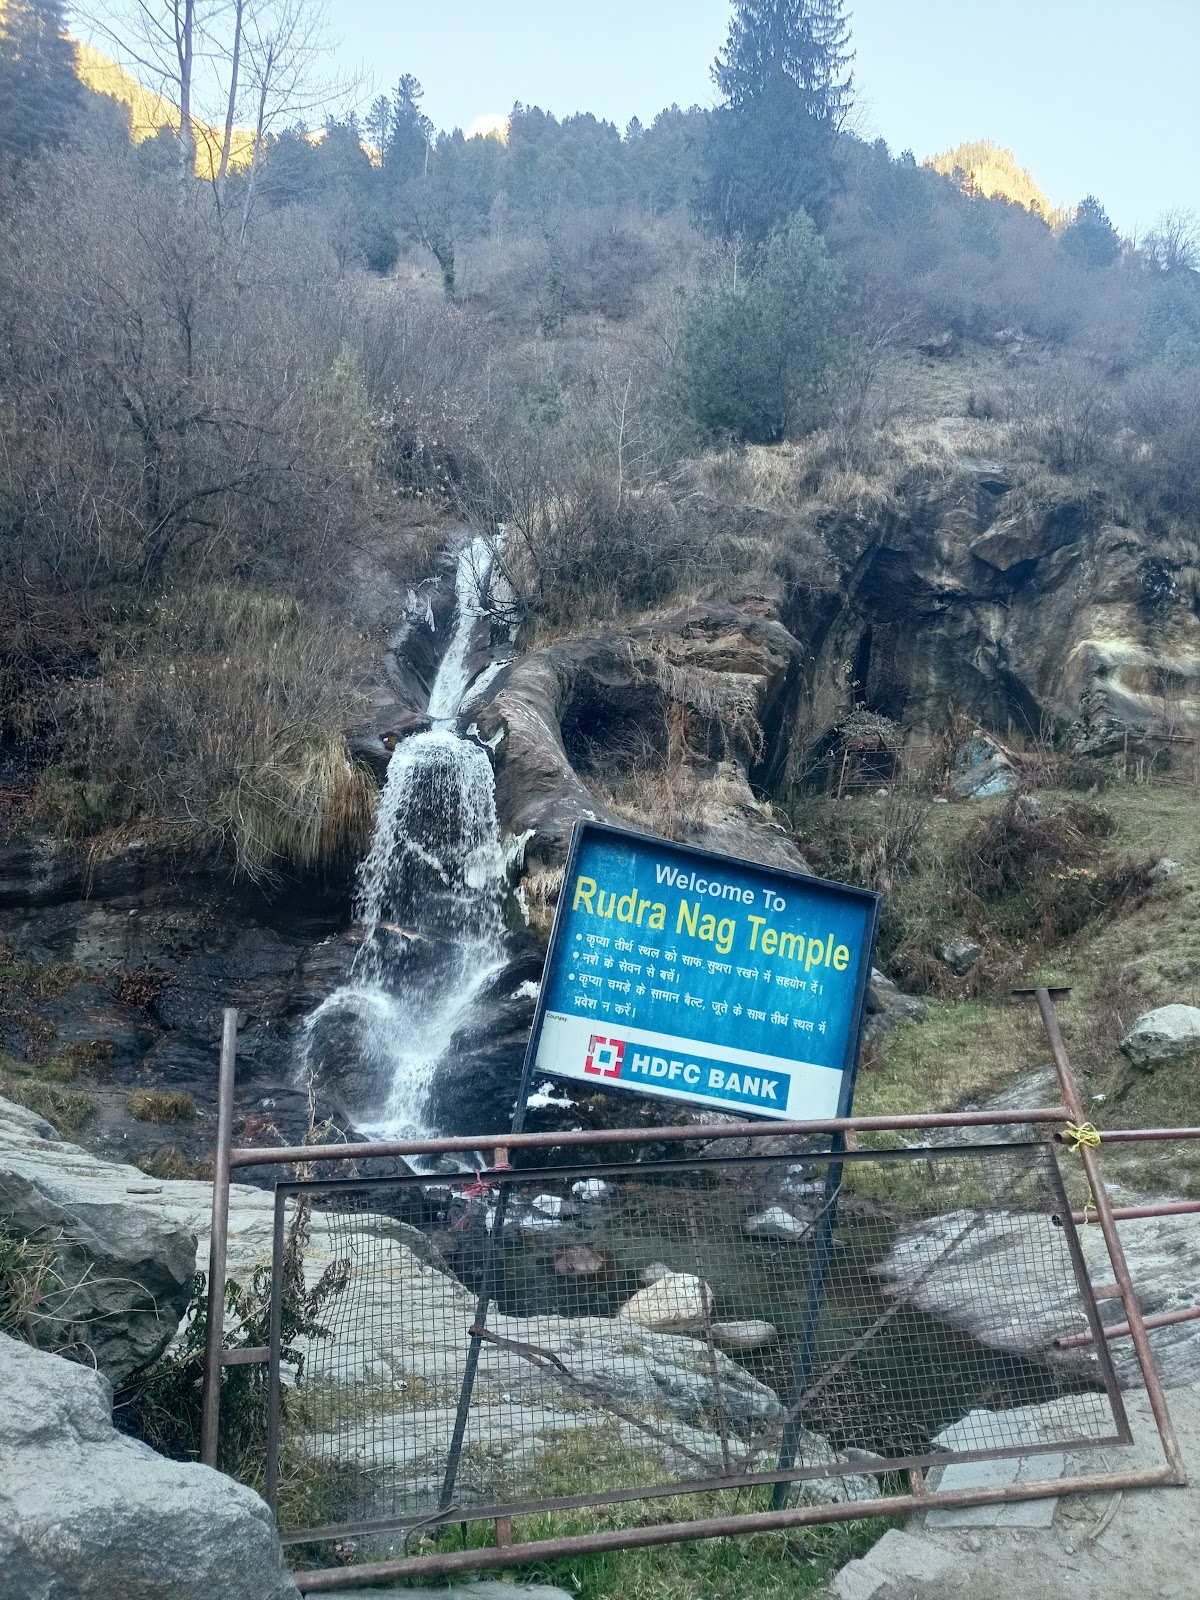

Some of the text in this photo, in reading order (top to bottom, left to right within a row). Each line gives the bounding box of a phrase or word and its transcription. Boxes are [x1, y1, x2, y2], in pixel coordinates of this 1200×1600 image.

[656, 864, 786, 912] Welcome To
[572, 875, 849, 972] Rudra Nag Temple
[582, 953, 599, 965] नशे
[603, 956, 614, 968] के
[619, 959, 641, 974] सेवन
[646, 964, 655, 977] से
[614, 938, 634, 952] तीर्थ
[638, 945, 660, 958] स्थल
[664, 949, 677, 962] को
[682, 955, 703, 967] साफ
[707, 960, 732, 974] सुथरा
[736, 967, 759, 980] रखने
[763, 970, 771, 983] में
[776, 975, 806, 990] सहयोग
[574, 994, 597, 1009] प्रवेश
[602, 1001, 610, 1012] न
[608, 978, 631, 994] चमड़े
[636, 983, 646, 995] के
[651, 988, 680, 1003] सामान
[684, 993, 706, 1010] बैल्ट,
[712, 1001, 728, 1016] जूते
[733, 1003, 743, 1016] के
[747, 1008, 766, 1021] साथ
[771, 1011, 789, 1026] तीर्थ
[793, 1018, 814, 1031] स्थल
[818, 1021, 827, 1034] में
[631, 1053, 779, 1100] HDFC BANK
